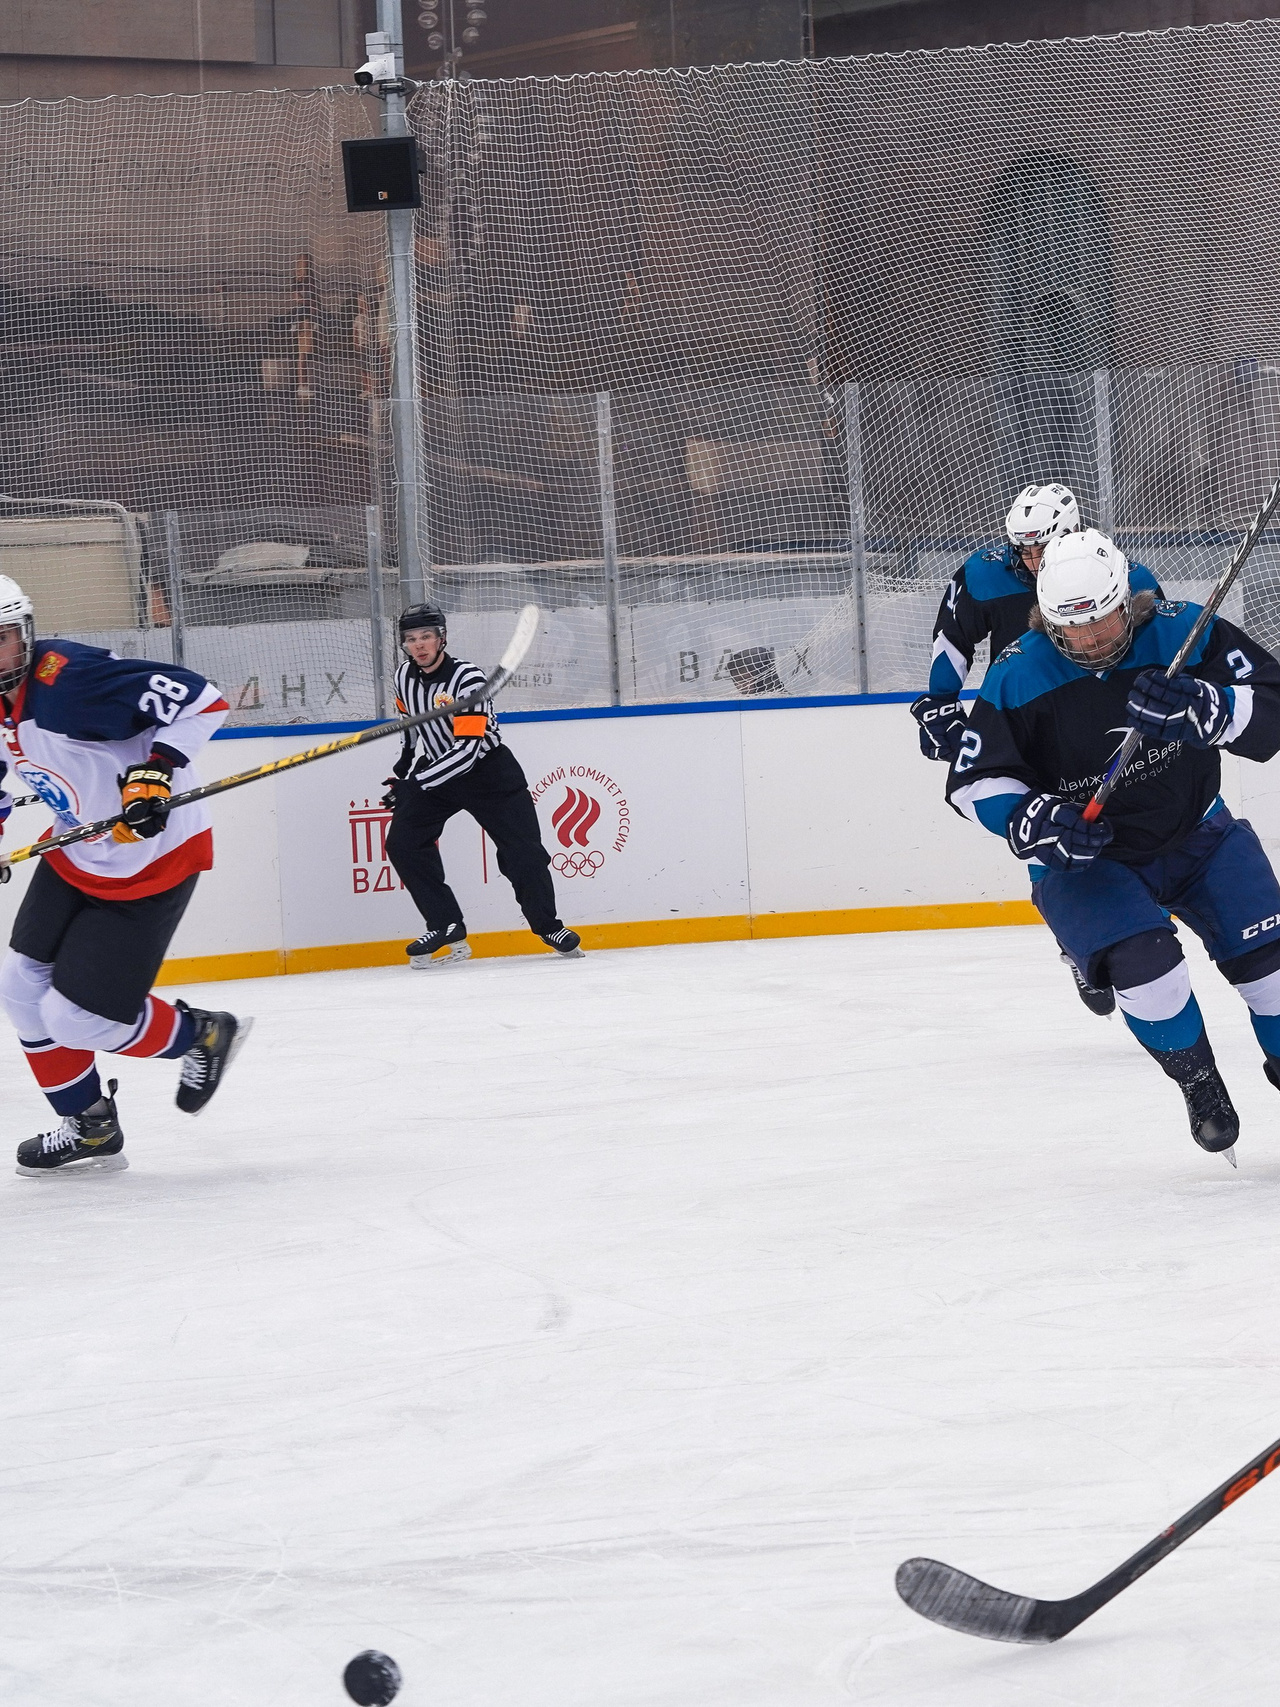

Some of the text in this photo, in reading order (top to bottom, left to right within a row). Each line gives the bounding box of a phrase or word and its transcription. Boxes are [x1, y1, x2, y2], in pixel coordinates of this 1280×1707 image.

[679, 645, 813, 683] ВДХ
[138, 674, 189, 725] 28
[210, 671, 348, 710] ДНХ
[954, 729, 982, 773] 2
[127, 769, 173, 787] BAU
[569, 766, 623, 797] КОМИТЕТ
[612, 799, 631, 853] РОССИИ
